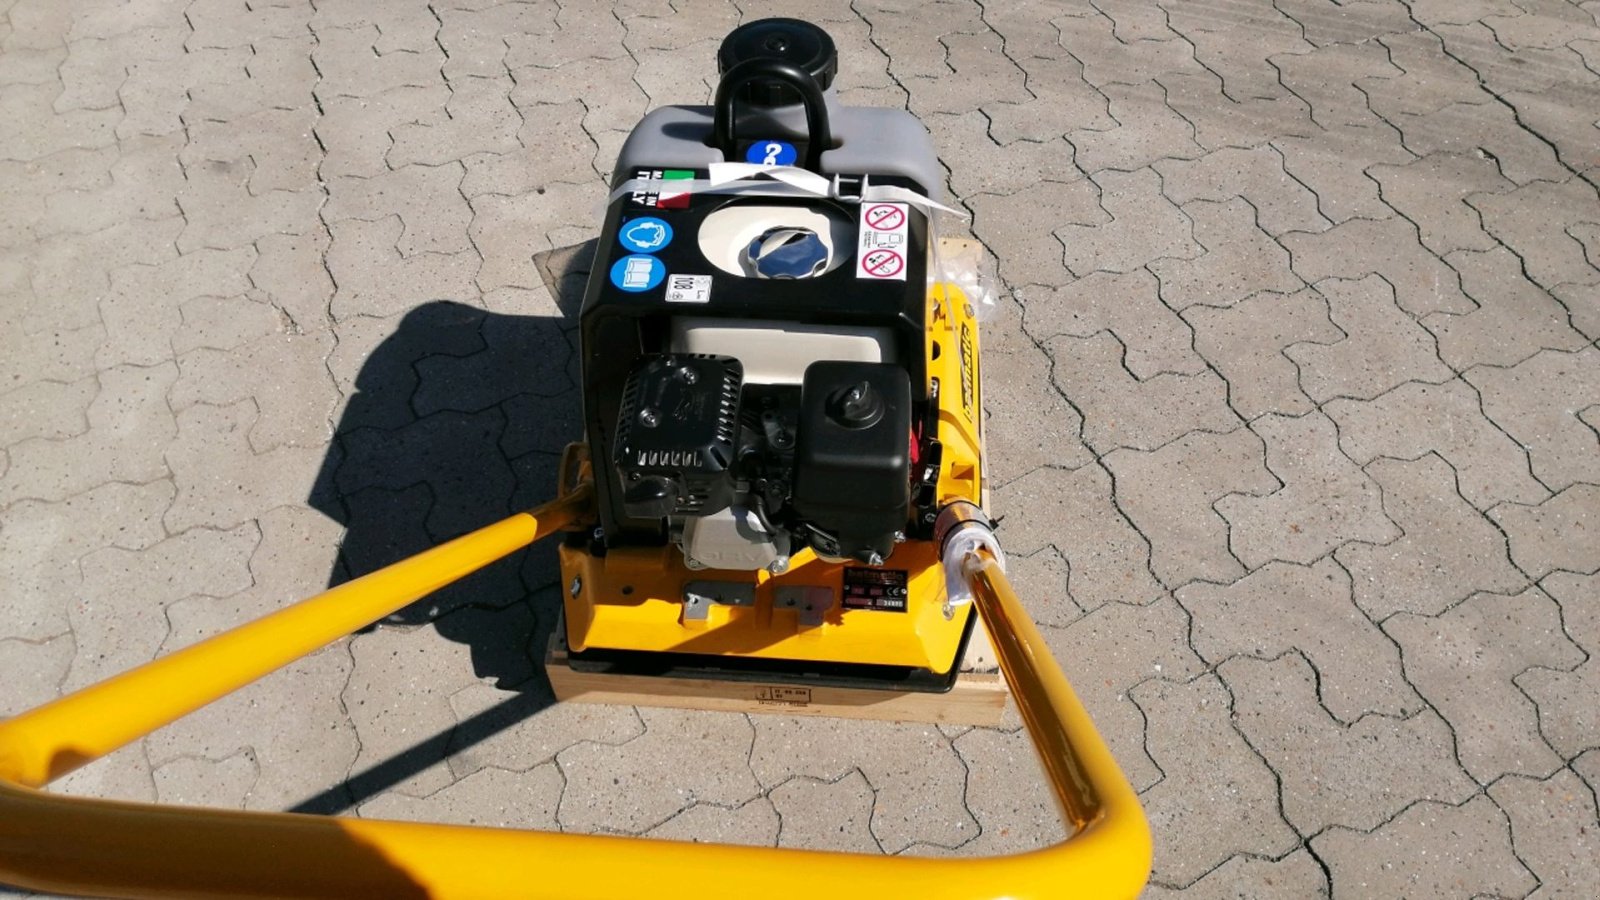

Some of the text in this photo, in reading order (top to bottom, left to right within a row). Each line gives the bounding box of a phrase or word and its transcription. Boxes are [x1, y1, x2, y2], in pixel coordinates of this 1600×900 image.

[632, 171, 650, 204] ITLY
[646, 196, 657, 206] IN
[674, 277, 694, 289] 108
